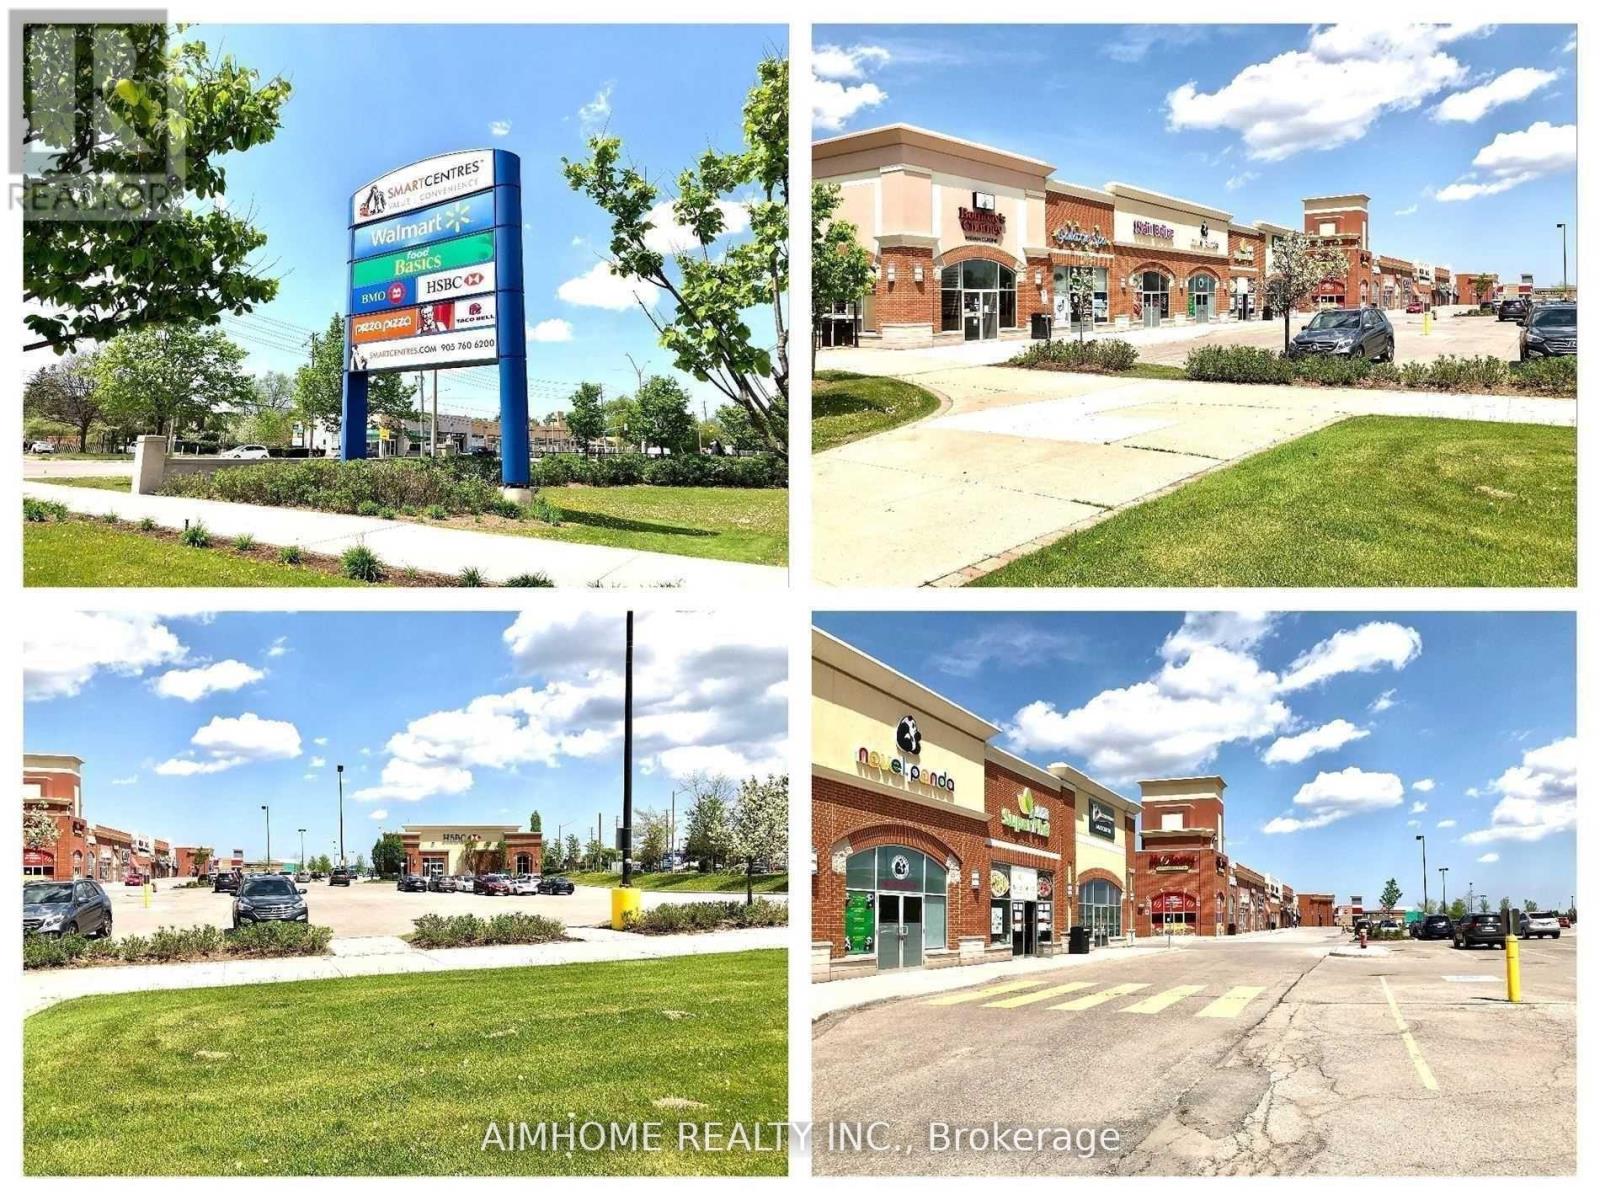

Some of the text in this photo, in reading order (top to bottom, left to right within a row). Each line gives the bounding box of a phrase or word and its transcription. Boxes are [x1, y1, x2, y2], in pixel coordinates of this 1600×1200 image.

[371, 213, 442, 247] Walmart
[395, 255, 442, 276] Basics
[427, 276, 463, 294] HSBC
[361, 290, 386, 304] BMO
[369, 338, 495, 359] SMARTCENTRES.COM 905 760 6200
[910, 766, 955, 792] panda
